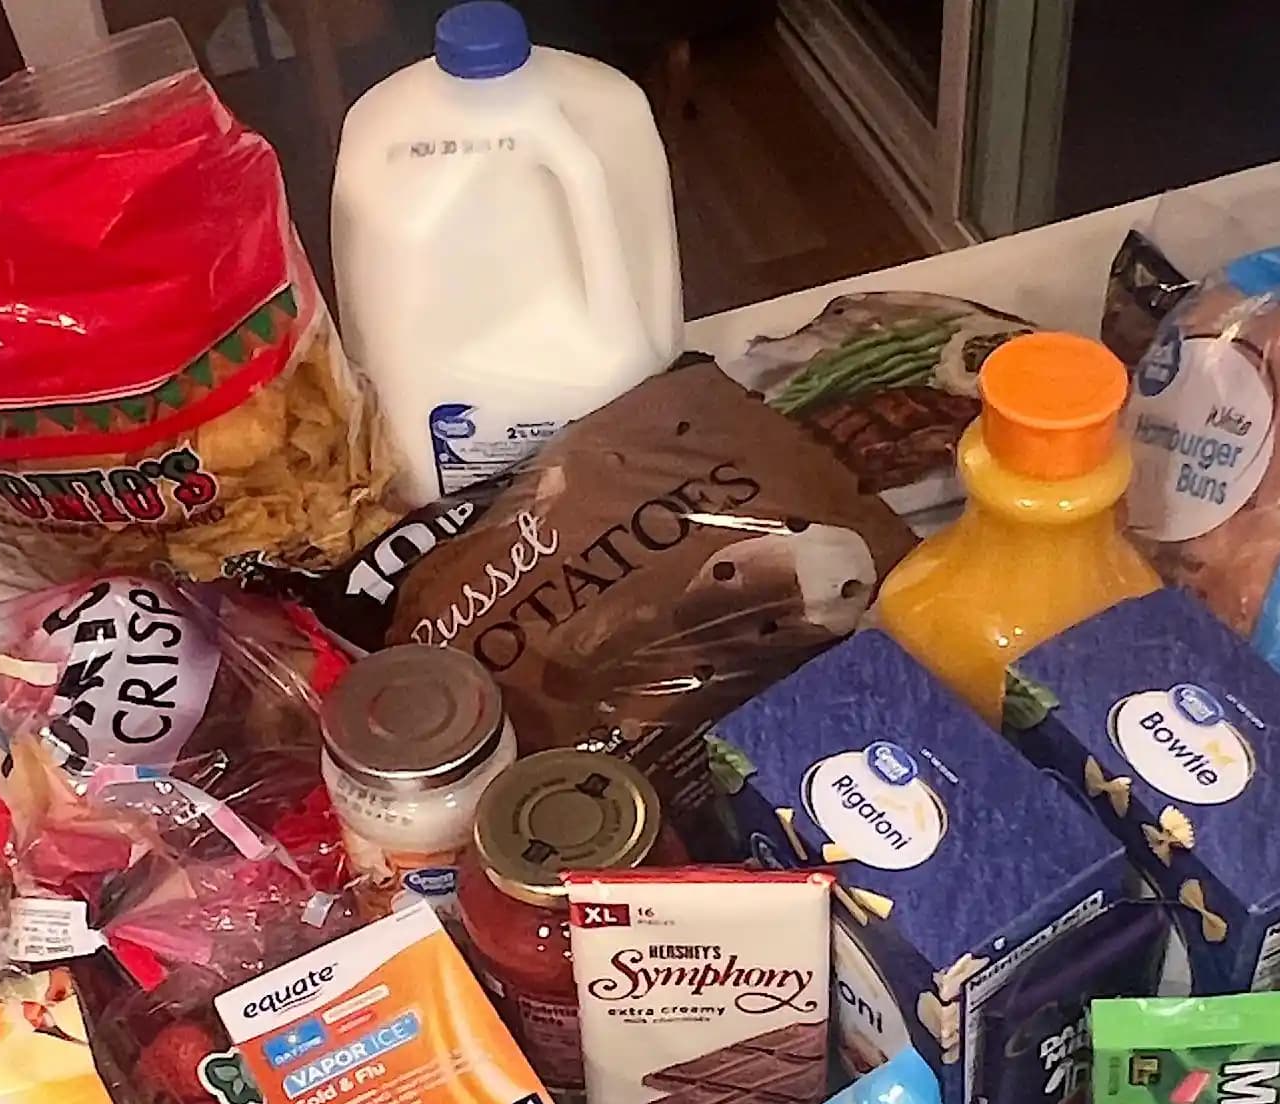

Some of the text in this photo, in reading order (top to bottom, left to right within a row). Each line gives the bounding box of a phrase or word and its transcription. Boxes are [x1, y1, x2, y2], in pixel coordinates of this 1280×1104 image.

[1134, 413, 1244, 470] Hamburger
[1175, 463, 1228, 505] Buns
[345, 520, 438, 605] 10
[410, 510, 560, 650] Russet
[473, 463, 761, 673] OTATOES
[112, 588, 182, 744] CRISP
[1140, 711, 1218, 786] Bowtie
[831, 775, 913, 851] Rigatoni
[584, 907, 618, 923] XL
[637, 907, 655, 917] 16
[588, 948, 818, 1014] Symphony
[648, 945, 722, 961] HERSHEY'S
[243, 963, 336, 1020] equate
[607, 1004, 726, 1018] extra creamy
[287, 1020, 408, 1089] VAPOR ICE
[339, 1077, 356, 1093] &
[356, 1063, 388, 1085] Flu
